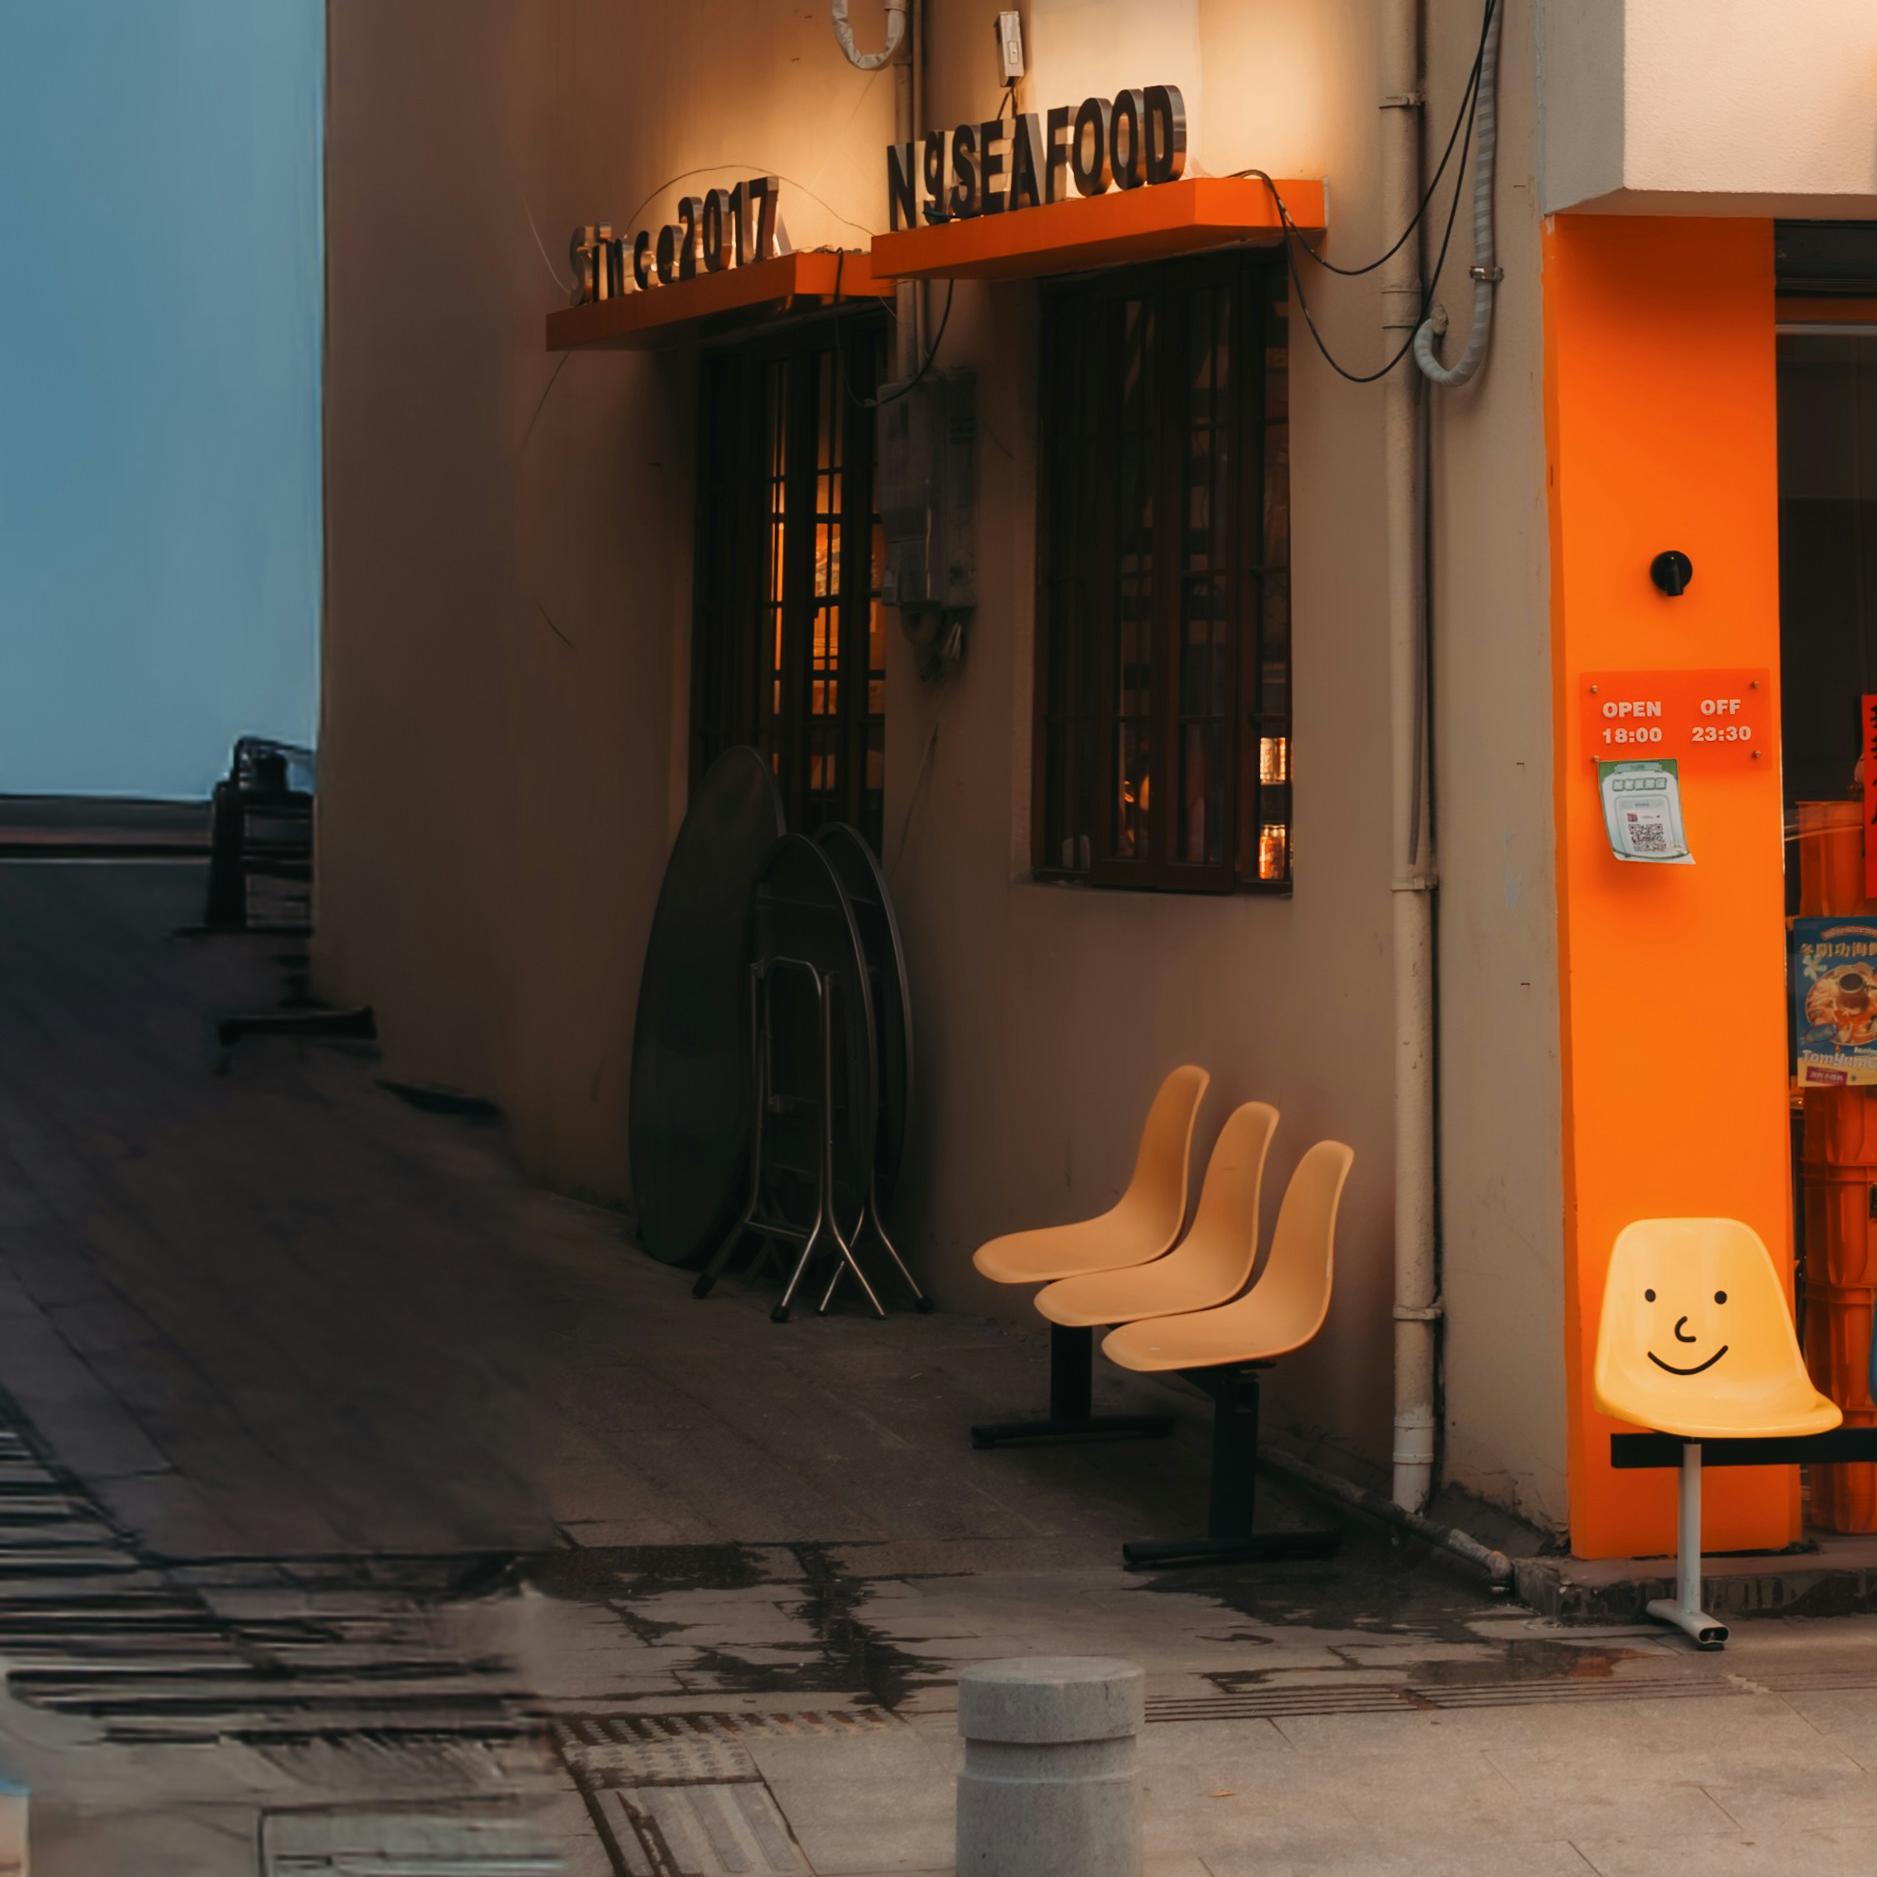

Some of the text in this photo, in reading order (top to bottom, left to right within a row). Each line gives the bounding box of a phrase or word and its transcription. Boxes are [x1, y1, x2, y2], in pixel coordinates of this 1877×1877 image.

[1602, 699, 1741, 718] OPEN OFF
[1602, 725, 1752, 744] 18:00 23:30
